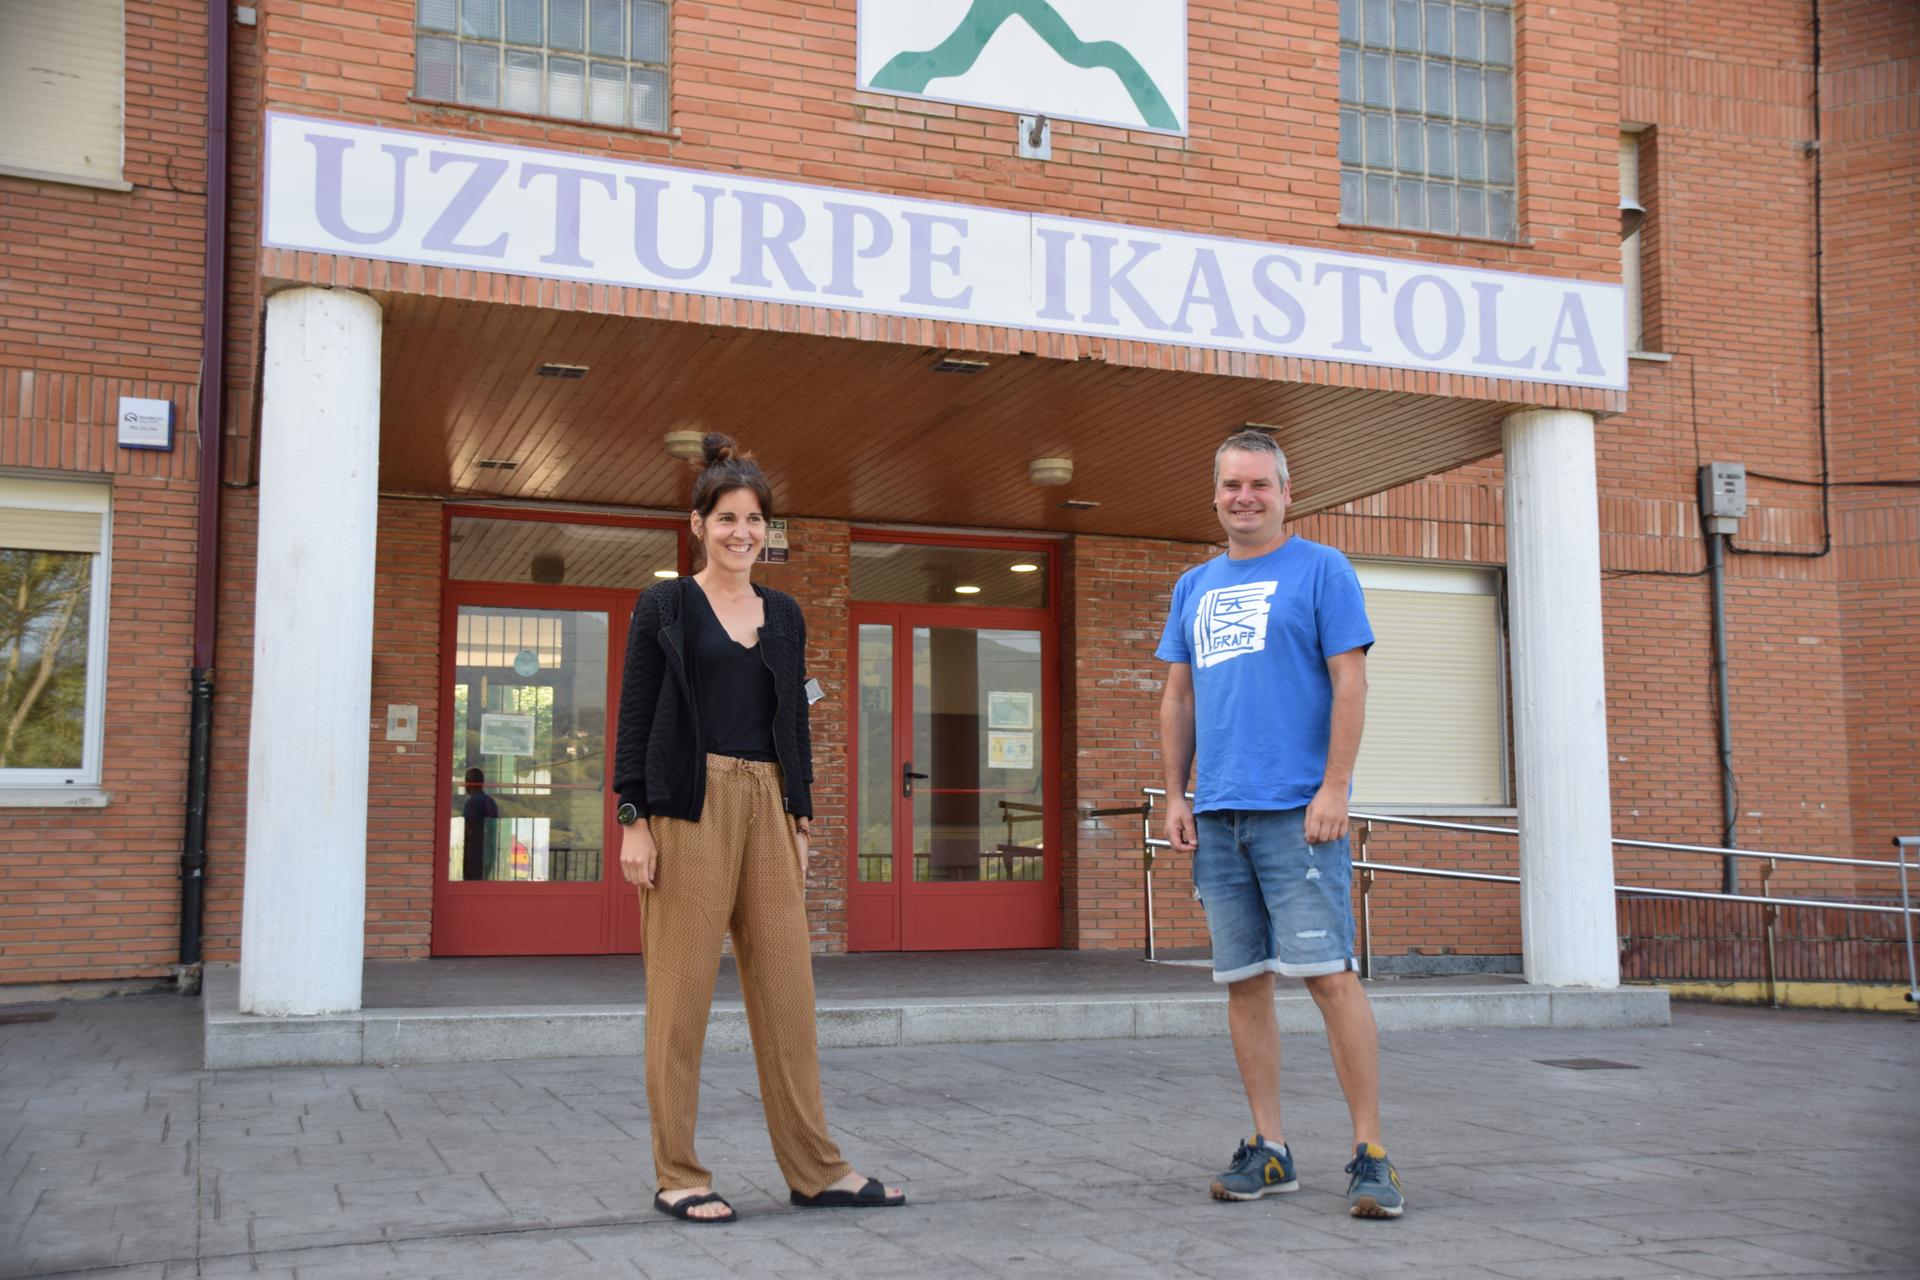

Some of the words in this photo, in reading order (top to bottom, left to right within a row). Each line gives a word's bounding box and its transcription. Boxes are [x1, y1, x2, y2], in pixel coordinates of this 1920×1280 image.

[304, 134, 974, 310] UZTURPE
[1036, 228, 1606, 377] IKASTOLA
[1213, 631, 1255, 650] GRAFF
